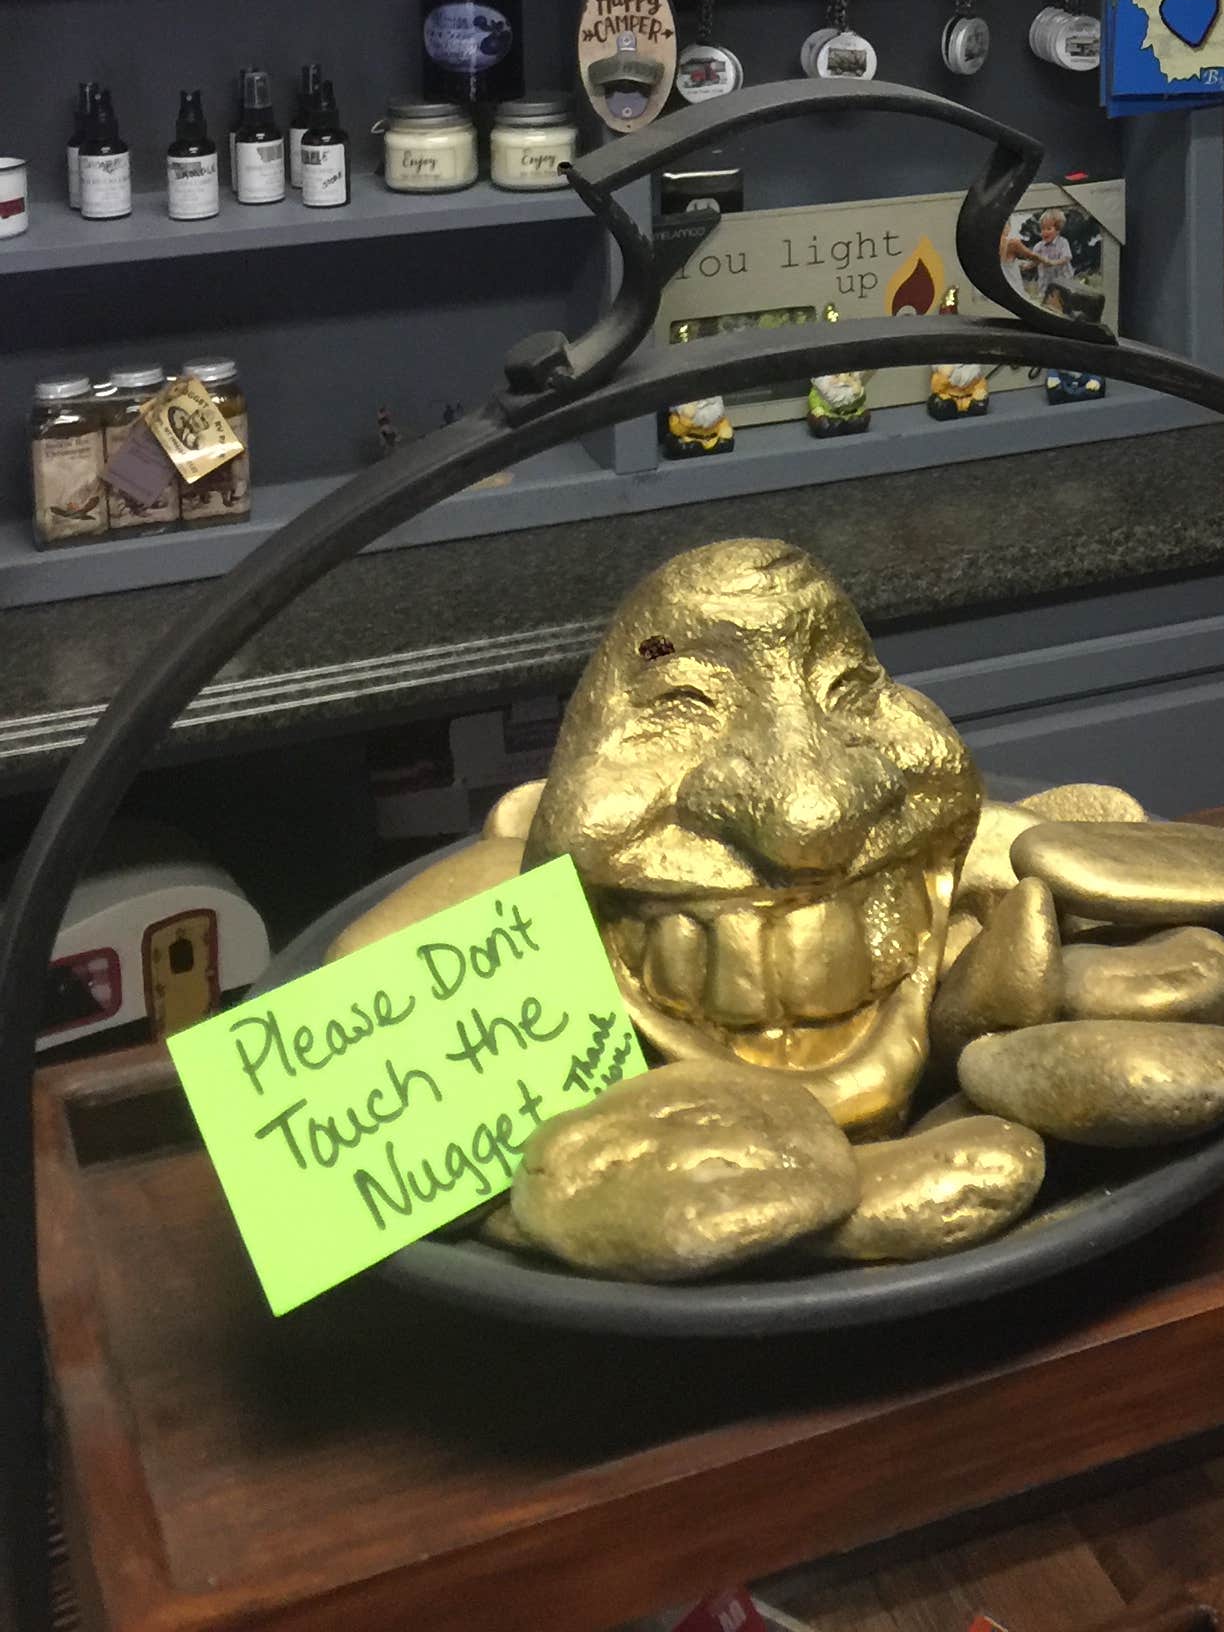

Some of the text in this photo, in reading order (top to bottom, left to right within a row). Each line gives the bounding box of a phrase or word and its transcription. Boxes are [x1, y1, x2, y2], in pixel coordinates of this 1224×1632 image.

[593, 14, 663, 44] CAMPER
[674, 229, 903, 280] ou light
[835, 271, 879, 299] up
[228, 899, 541, 1095] Please Don't
[254, 996, 570, 1171] Touch the
[353, 1078, 547, 1232] Nugget
